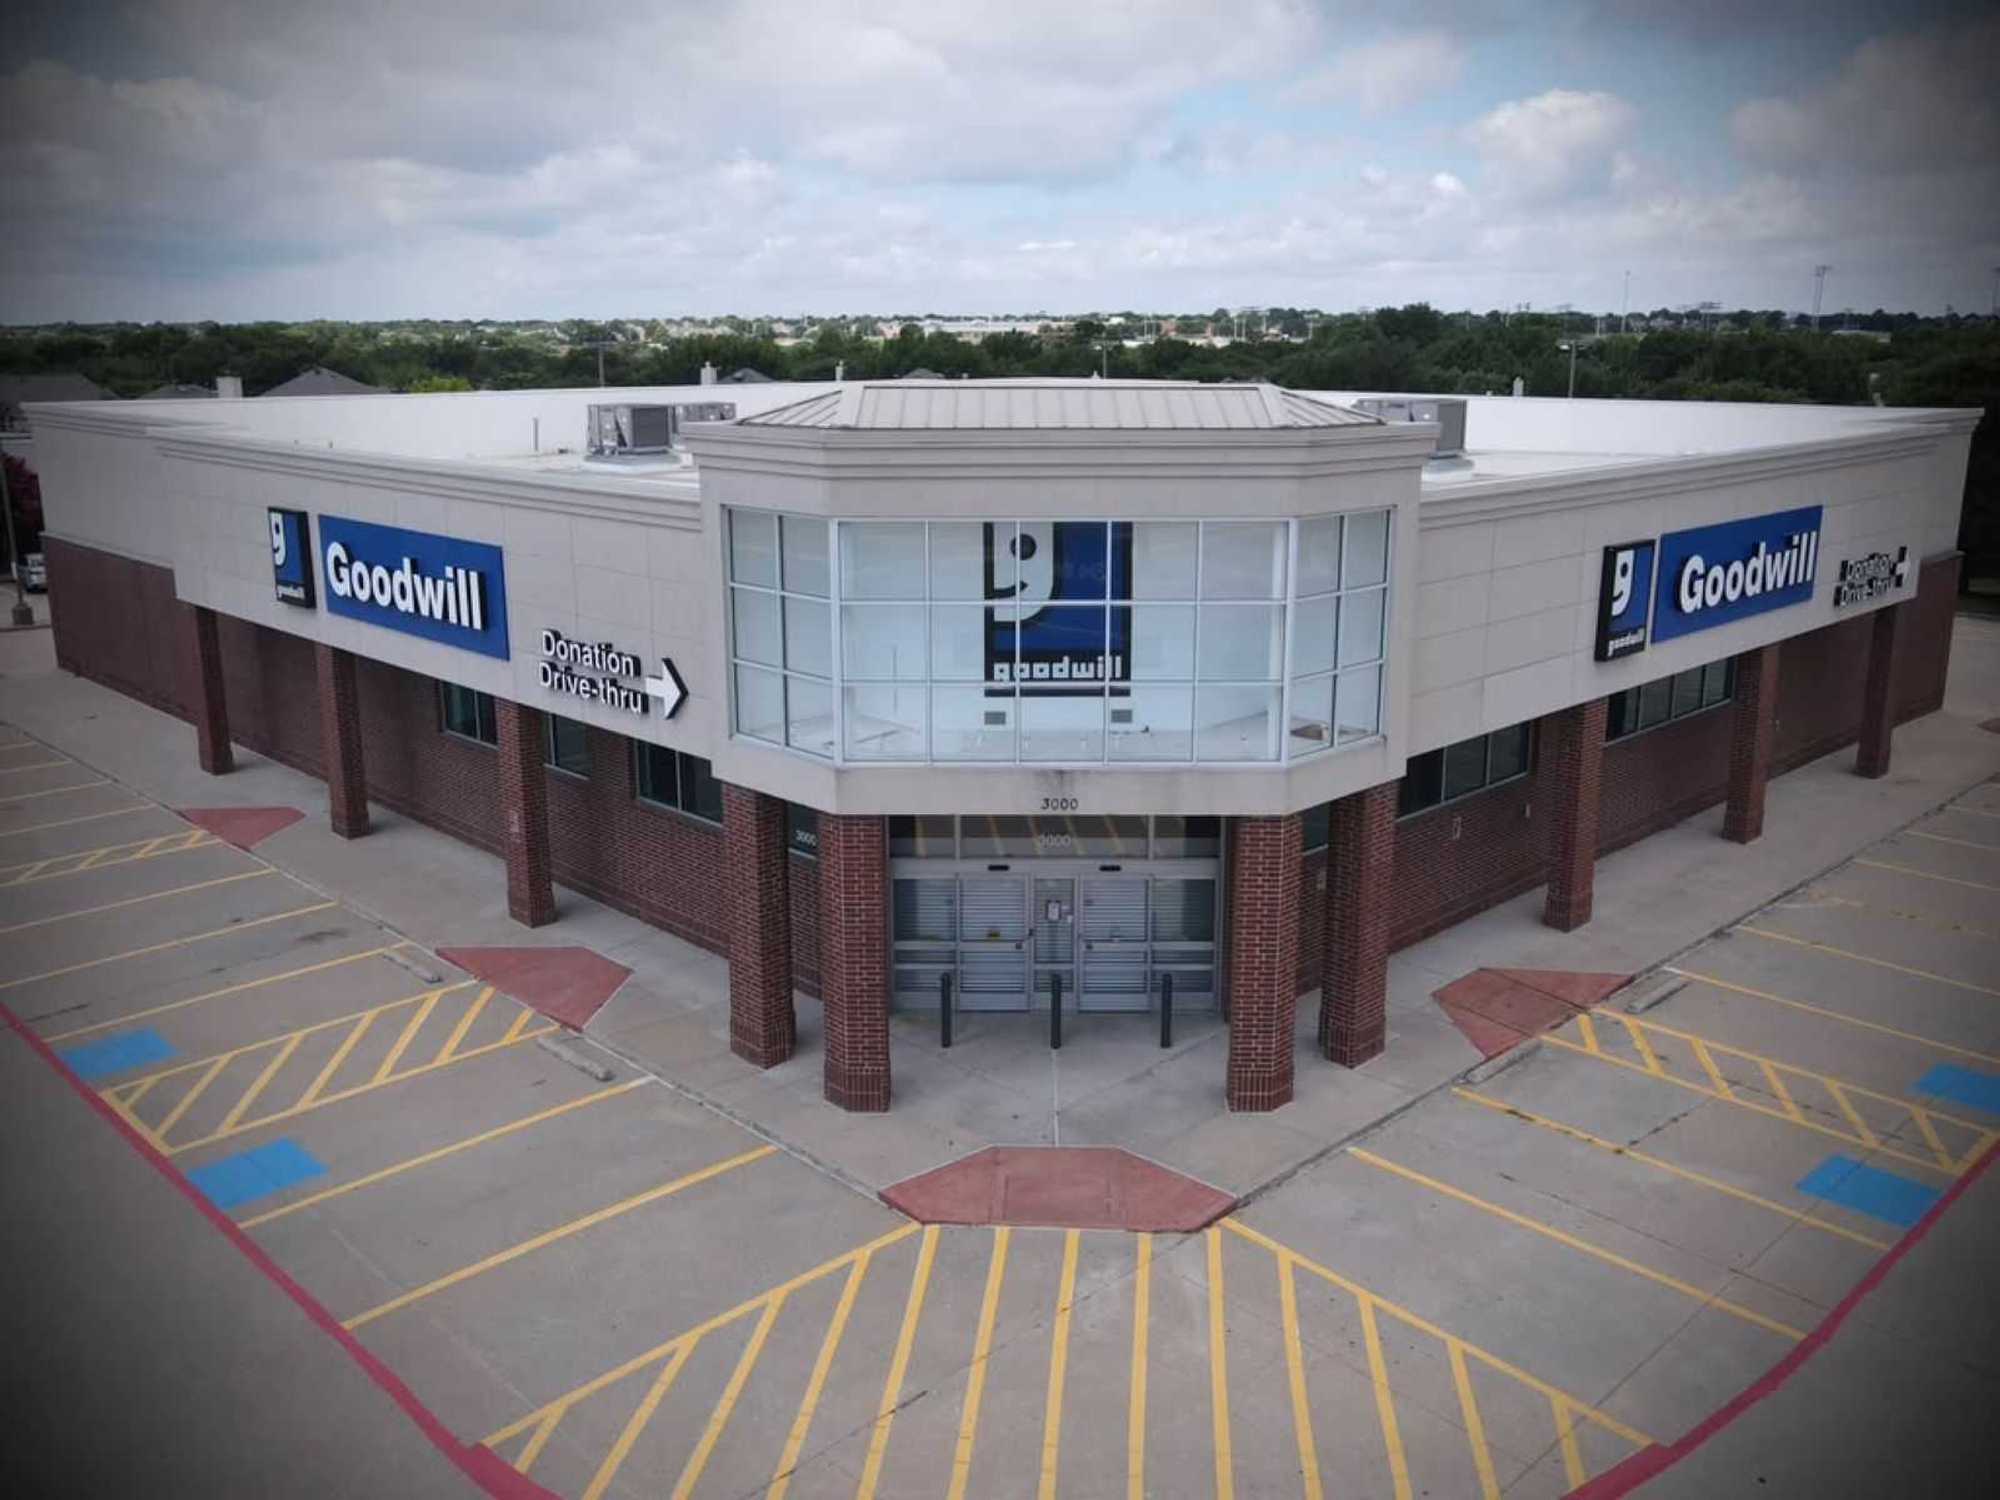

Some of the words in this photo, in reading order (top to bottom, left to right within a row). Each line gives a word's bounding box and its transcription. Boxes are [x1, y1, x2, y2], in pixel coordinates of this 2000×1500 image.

[326, 541, 483, 631] Goodwill
[1680, 531, 1817, 614] Goodwill
[542, 630, 637, 679] Donation
[993, 655, 1122, 684] goodwill
[539, 661, 643, 716] Drive-thru
[1040, 797, 1079, 811] 3000
